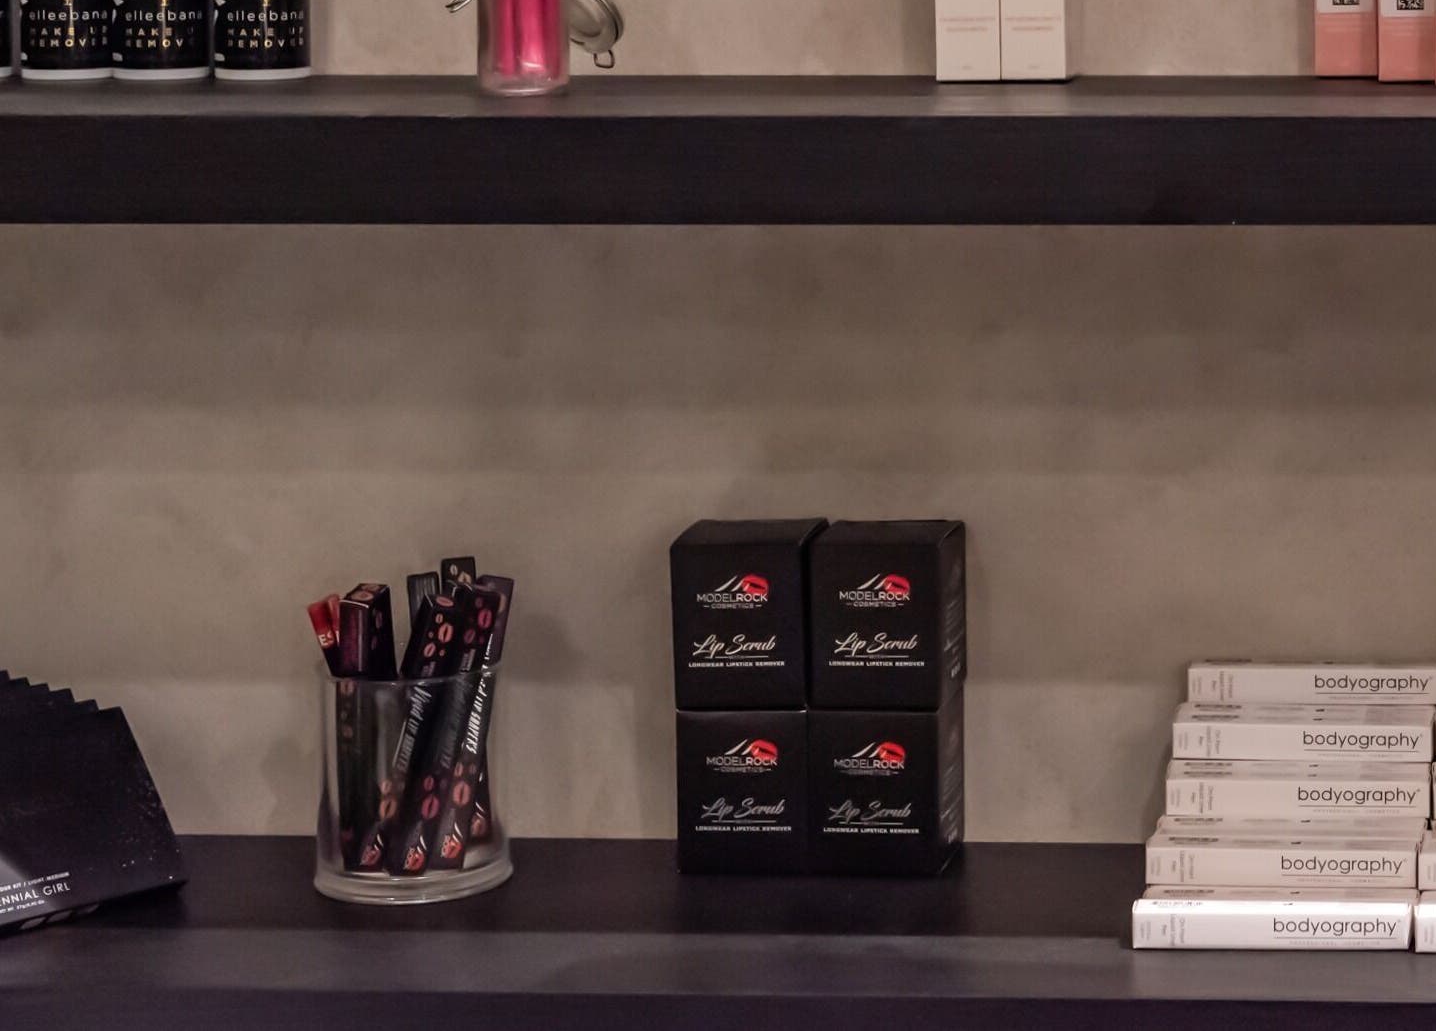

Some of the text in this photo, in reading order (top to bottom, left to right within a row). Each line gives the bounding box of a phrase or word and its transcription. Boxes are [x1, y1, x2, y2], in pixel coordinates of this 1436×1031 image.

[29, 10, 107, 20] elleebana
[228, 10, 303, 21] elleebana
[697, 594, 768, 602] MODELROCK
[839, 591, 910, 601] MODELROCK
[693, 634, 776, 658] Lip Scrub
[834, 632, 918, 656] Lip Scrub
[1315, 674, 1428, 691] bodyography
[1303, 730, 1419, 749] bodyography
[706, 757, 777, 766] MODELROCK
[834, 759, 904, 769] MODELROCK
[1298, 787, 1416, 804] bodyography
[701, 797, 785, 821] Lip Scrub
[828, 800, 912, 824] Lip Scrub
[1281, 855, 1403, 874] bodyography
[0, 882, 70, 906] NNIAL GIRL
[1273, 918, 1397, 936] bodyography
